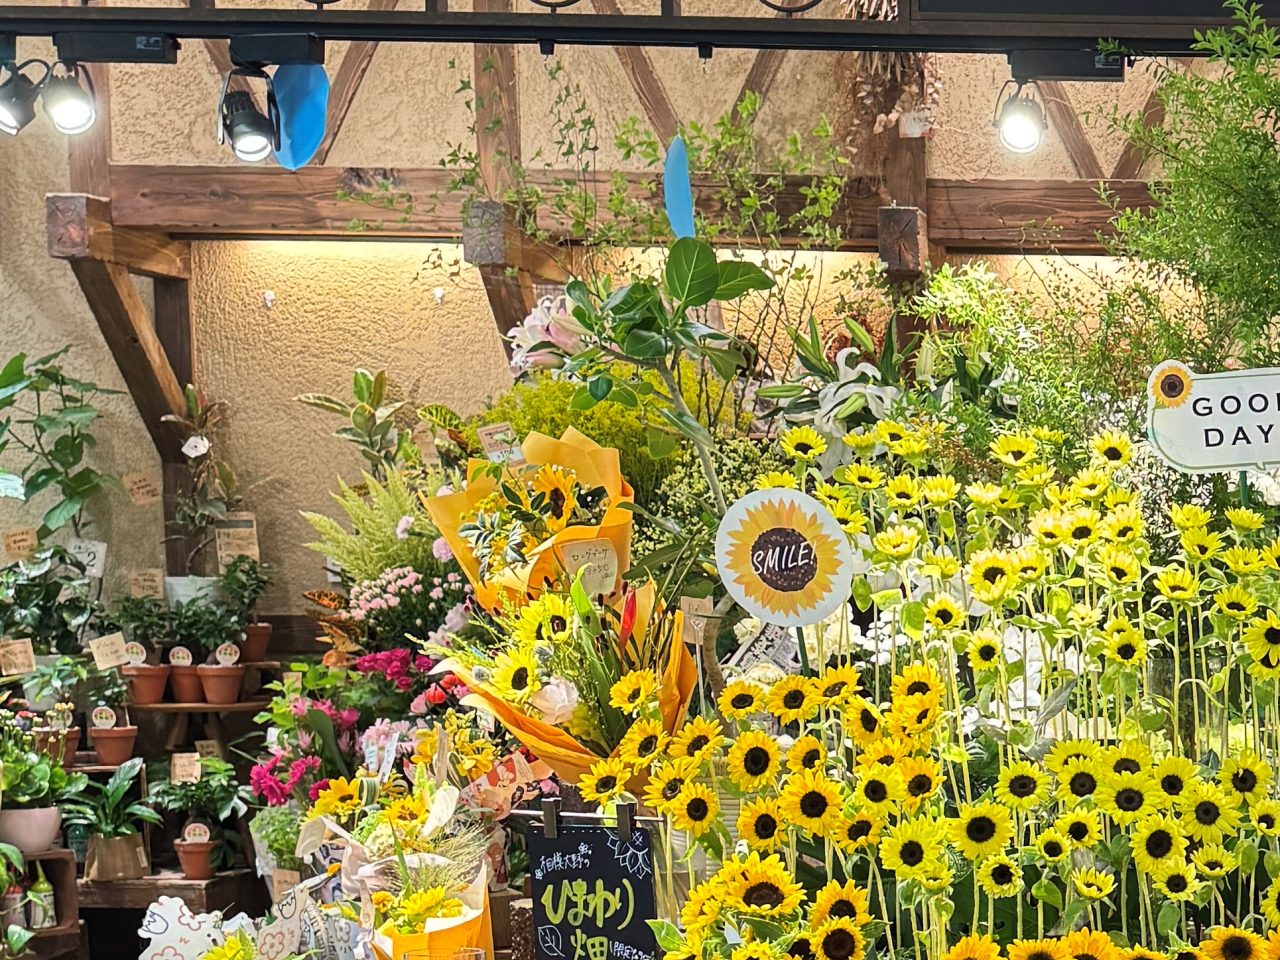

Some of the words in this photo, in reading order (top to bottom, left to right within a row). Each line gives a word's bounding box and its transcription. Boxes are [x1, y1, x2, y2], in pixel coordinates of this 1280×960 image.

[753, 540, 817, 575] SMILE!
[541, 878, 635, 931] ひまわり
